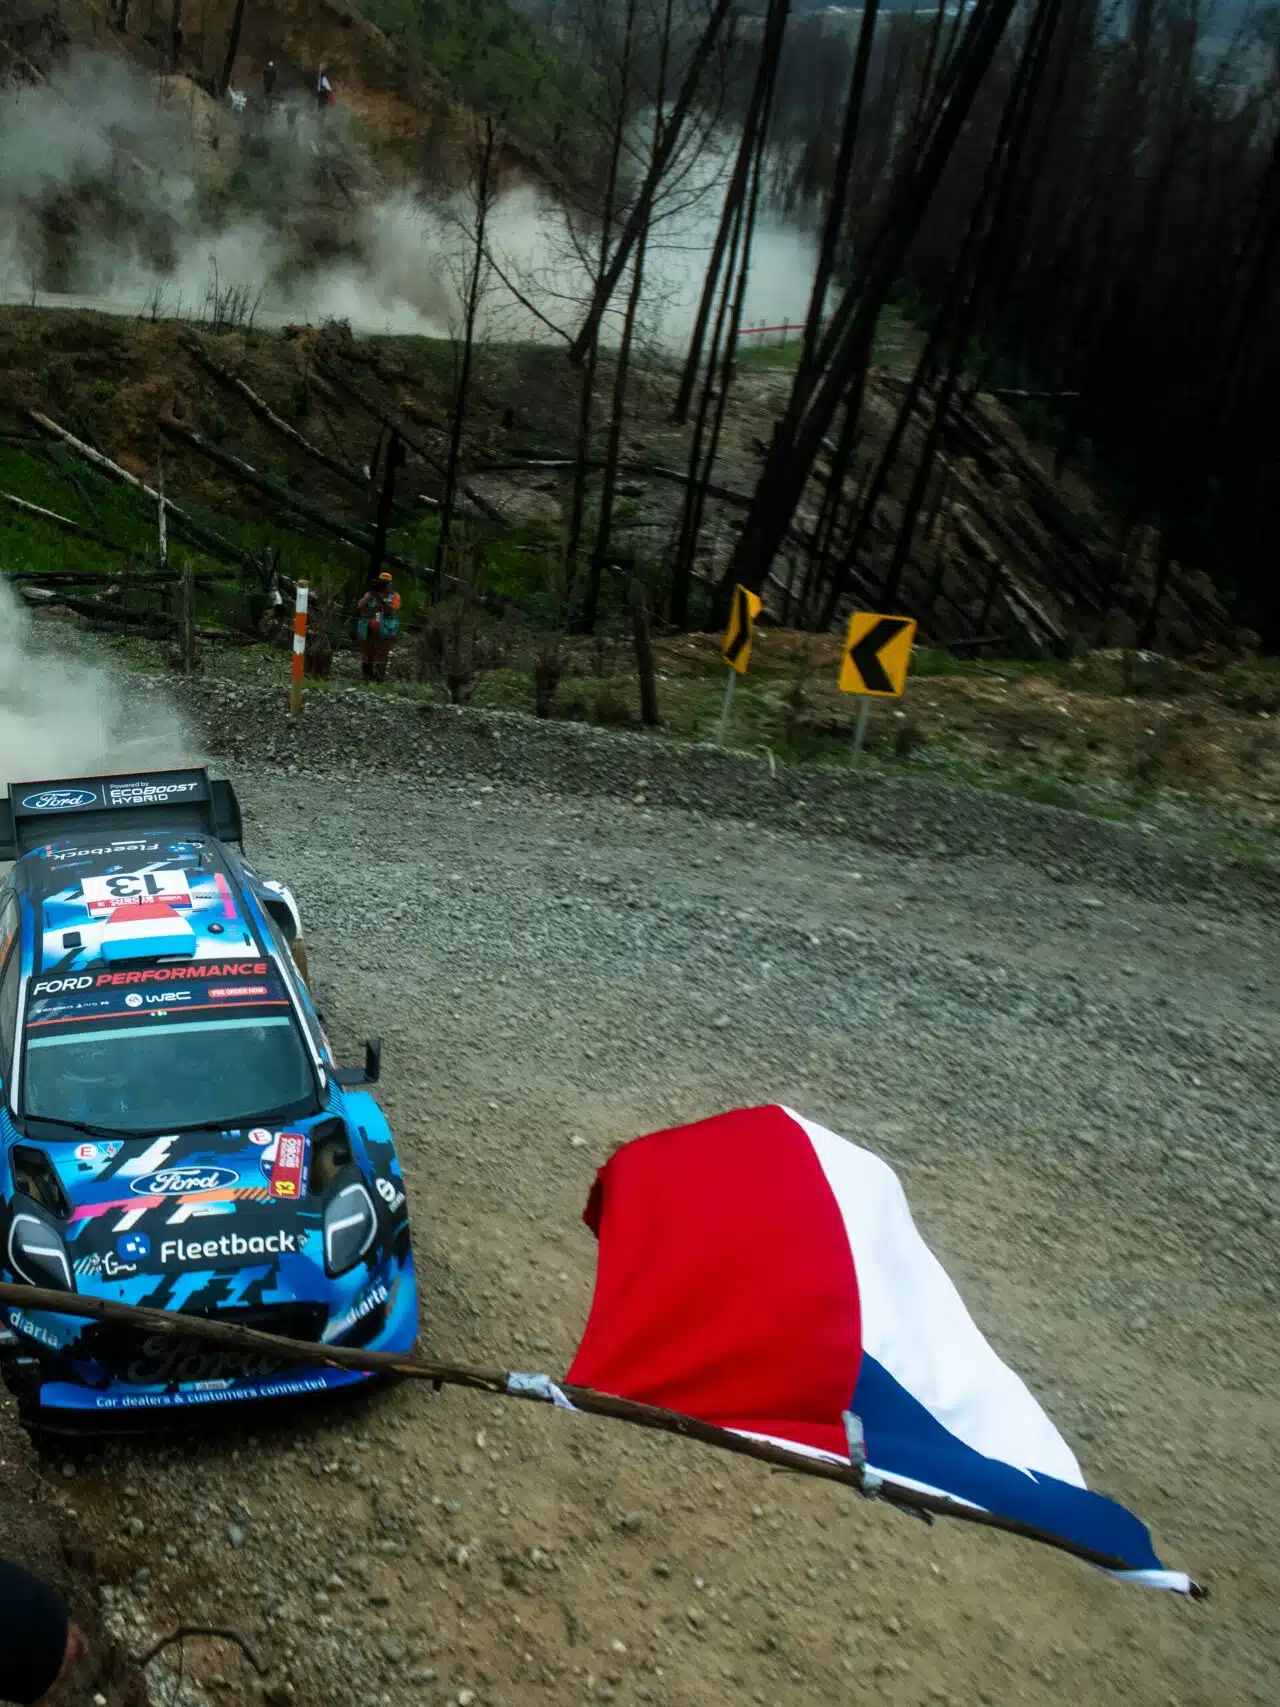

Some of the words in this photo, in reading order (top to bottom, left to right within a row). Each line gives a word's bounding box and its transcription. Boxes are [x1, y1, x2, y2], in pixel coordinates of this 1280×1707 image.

[36, 791, 84, 808] Ford
[110, 783, 198, 798] ECOBOOST
[112, 793, 169, 805] HYBRID
[54, 843, 159, 861] Fleetback
[106, 874, 165, 897] 13
[33, 976, 93, 996] FORD
[95, 963, 267, 987] PERFORMANCE
[146, 991, 191, 1003] WRC
[150, 1169, 220, 1193] Ford
[274, 1180, 296, 1196] 13
[160, 1229, 297, 1264] Fleetback
[96, 1395, 118, 1408] Car
[122, 1391, 170, 1407] dealers
[173, 1393, 185, 1405] &
[187, 1387, 258, 1404] customers
[260, 1376, 328, 1396] connected
